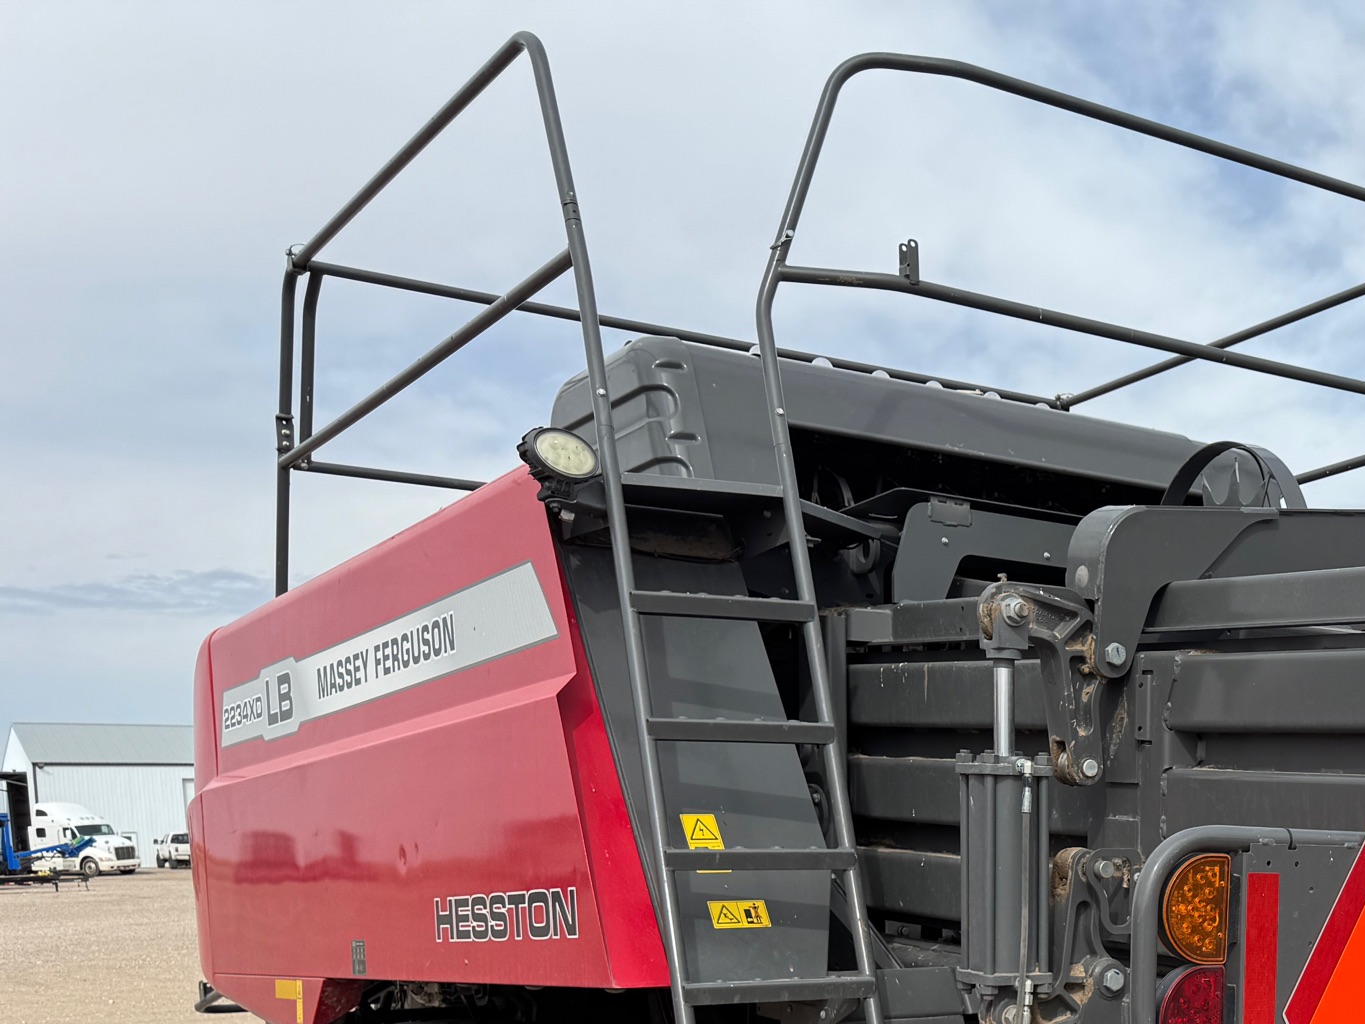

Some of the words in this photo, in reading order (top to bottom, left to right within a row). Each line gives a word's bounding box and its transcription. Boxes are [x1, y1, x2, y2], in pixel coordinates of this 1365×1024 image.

[316, 648, 369, 700] MASSEY
[373, 612, 456, 680] FERGUSON
[223, 695, 263, 730] 2234XD
[265, 670, 294, 728] LB
[433, 886, 579, 943] HESSTON
